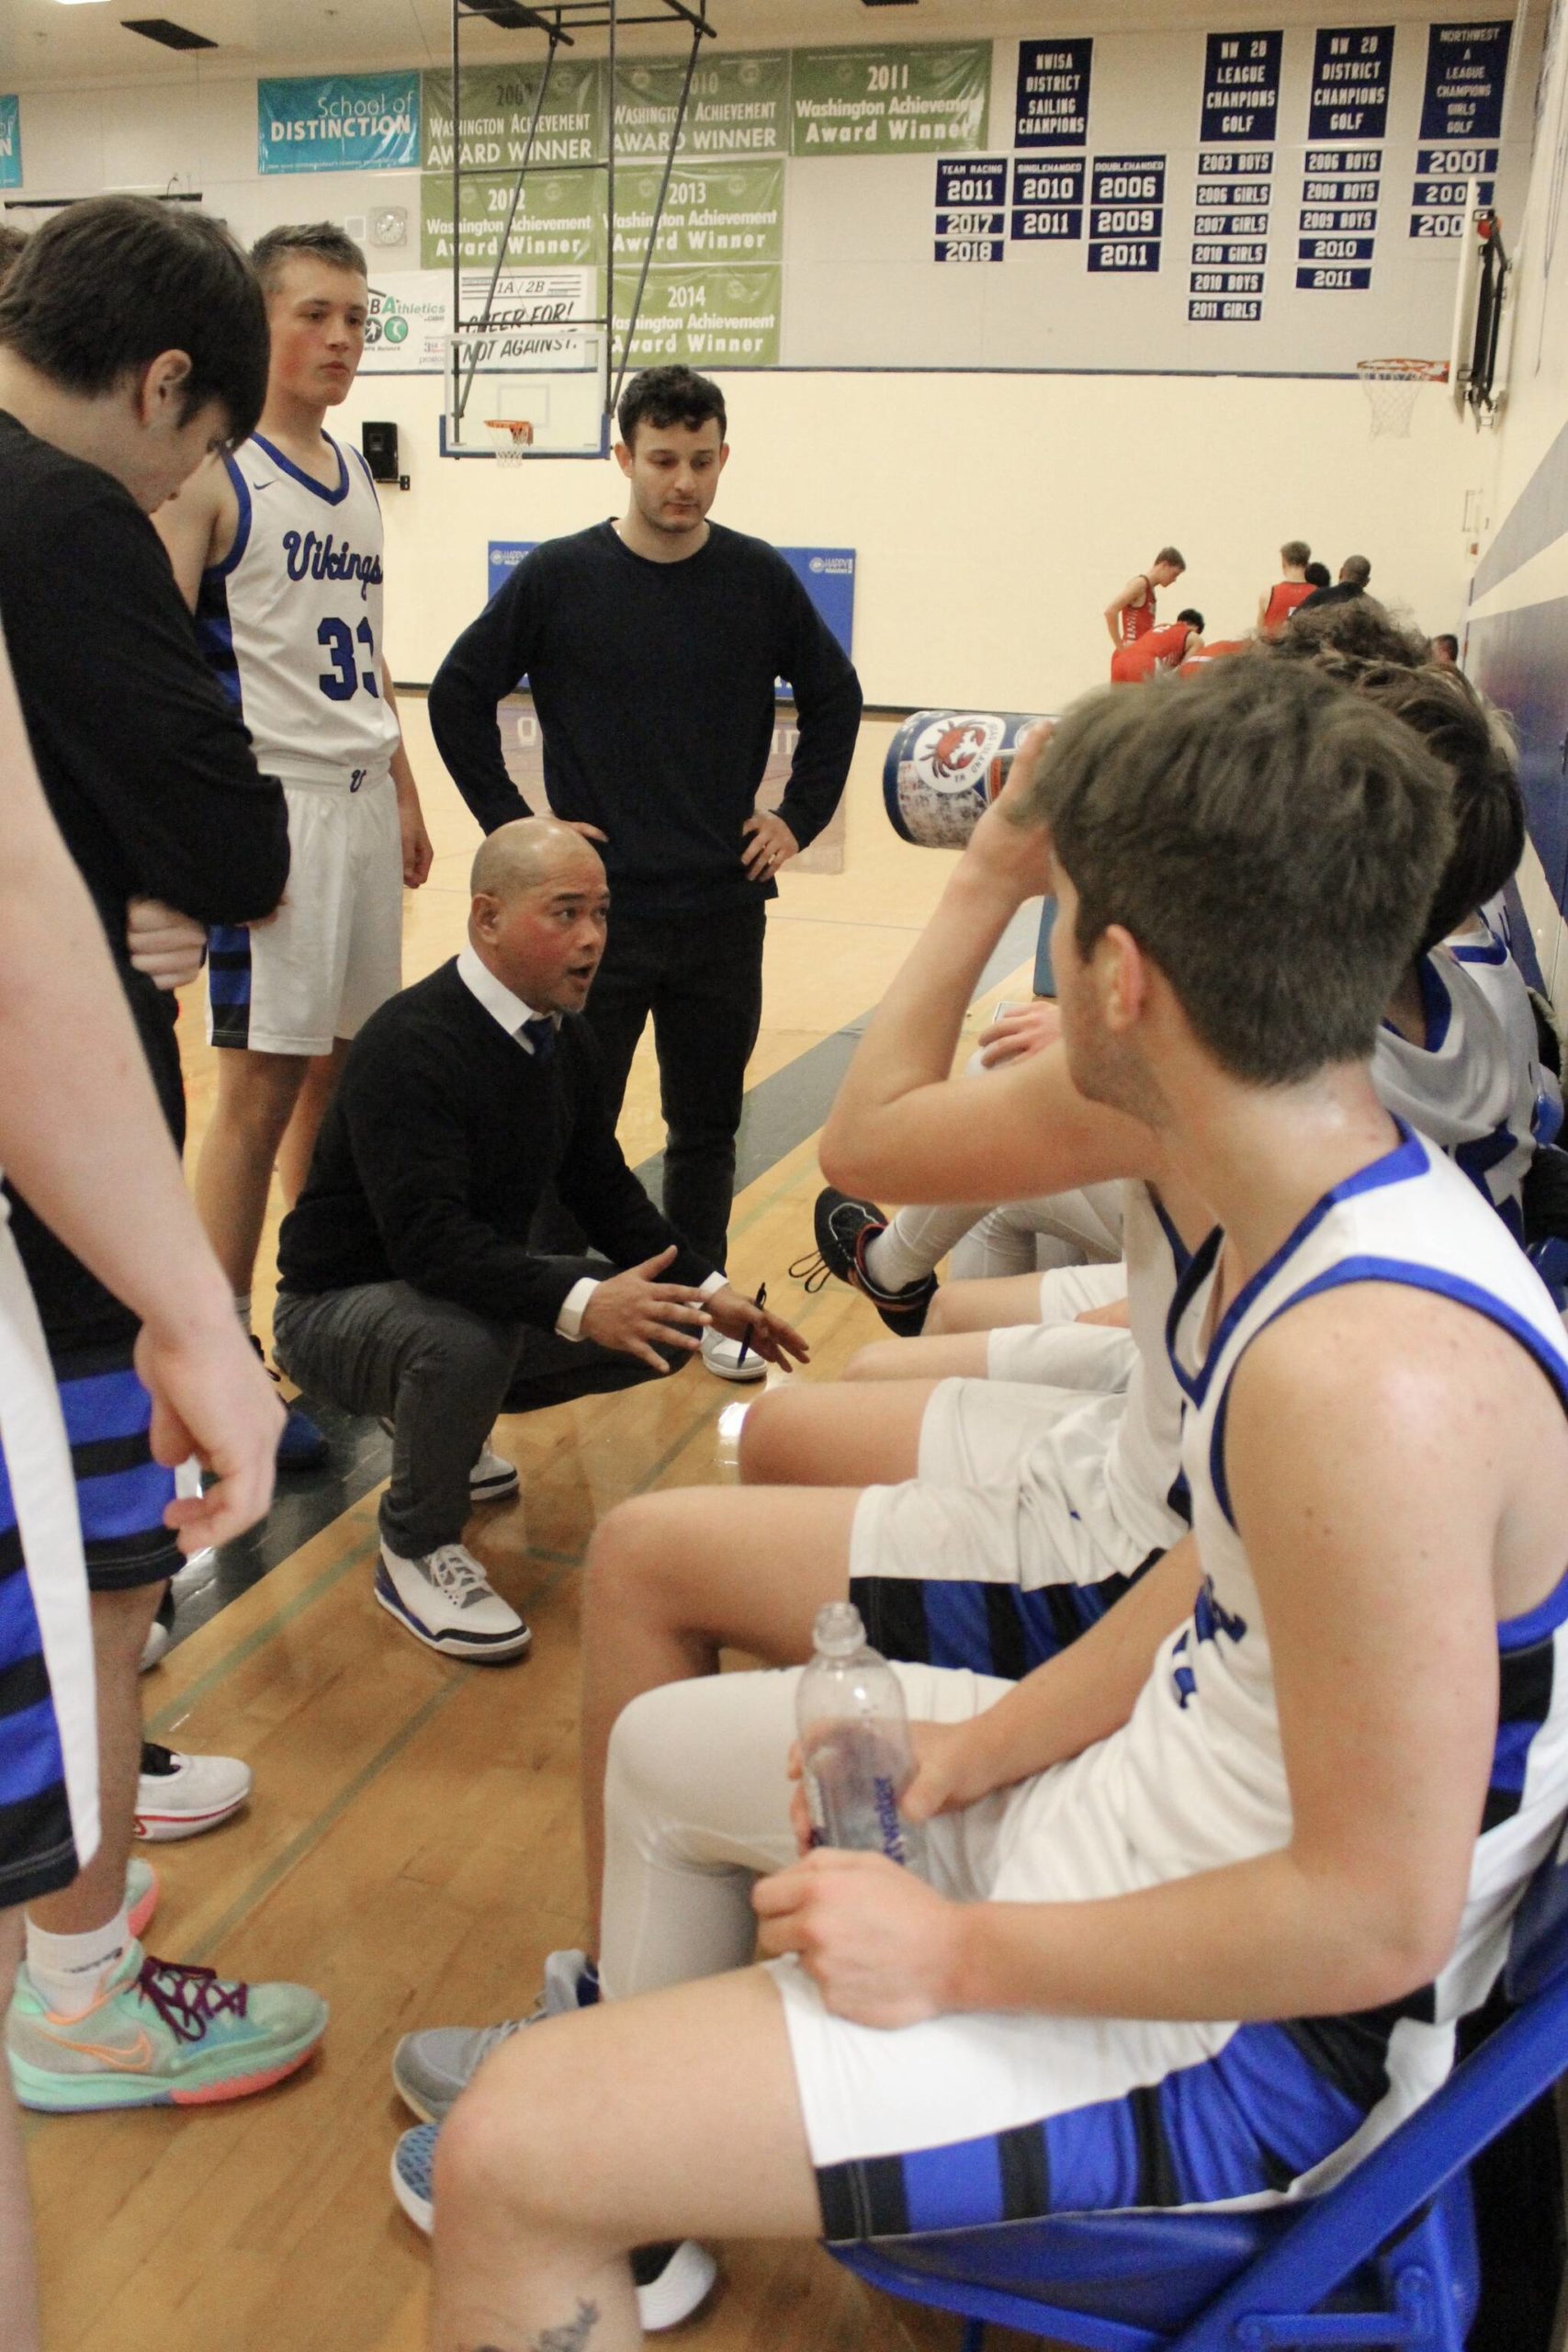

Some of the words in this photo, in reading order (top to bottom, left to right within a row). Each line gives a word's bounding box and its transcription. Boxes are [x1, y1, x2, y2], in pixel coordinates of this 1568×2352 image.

[1036, 53, 1073, 70] NWISA
[867, 64, 908, 91] 2011
[1217, 65, 1266, 84] LEAGUE
[1322, 62, 1381, 81] DISTRICT
[1446, 66, 1485, 80] LEAGUE
[681, 72, 718, 96] 010
[1026, 74, 1081, 92] DISTRICT
[318, 93, 386, 119] School
[392, 90, 414, 114] of
[1206, 90, 1275, 108] CHAMPIONS
[1314, 86, 1385, 107] CHAMPIONS
[694, 101, 776, 121] ACHIEVEMENT
[796, 98, 885, 120] Washington
[1028, 98, 1076, 115] SAILING
[271, 114, 412, 141] DISTINCTION
[806, 119, 877, 142] Award
[888, 118, 971, 141] Winner
[1018, 117, 1085, 134] CHAMPIONS
[1222, 115, 1255, 133] GOLF
[1330, 112, 1364, 130] GOLF
[613, 131, 686, 152] AWARD
[694, 127, 776, 150] WINNER
[427, 142, 501, 164] AWARD
[508, 139, 592, 162] WINNER
[942, 165, 965, 175] TEAM
[970, 164, 1002, 175] RACING
[1017, 163, 1082, 174] SINGLEHANDED
[1095, 161, 1164, 172] DOUBLEHANDED
[1237, 153, 1269, 171] BOYS
[1345, 153, 1377, 170] BOYS
[1429, 151, 1486, 173] 2001
[669, 182, 706, 205] 2013
[947, 179, 993, 200] 2011
[1022, 177, 1074, 199] 2010
[1100, 176, 1156, 198] 2006
[1233, 187, 1268, 203] GIRLS
[1343, 183, 1375, 199] BOYS
[1426, 186, 1481, 203] 200
[688, 209, 778, 227] Achievement
[947, 214, 993, 234] 2017
[1023, 212, 1068, 234] 2011
[1098, 210, 1155, 232] 2009
[1231, 216, 1267, 233] GIRLS
[1339, 211, 1372, 229] BOYS
[507, 235, 581, 254] Winner
[689, 231, 765, 249] Winner
[1314, 241, 1357, 257] 2010
[945, 242, 992, 261] 2018
[1100, 244, 1146, 266] 2011
[1195, 246, 1223, 263] 2010
[1228, 245, 1263, 262] GIRLS
[1194, 275, 1223, 291] 2010
[1228, 274, 1258, 290] BOYS
[1314, 270, 1352, 287] 2011
[668, 286, 705, 308] 2014
[1192, 302, 1217, 319] 2011
[1223, 302, 1258, 319] GIRLS
[687, 312, 775, 329] Achievement
[463, 341, 498, 363] NOT
[612, 334, 676, 353] Award
[687, 334, 763, 353] Winner
[283, 530, 383, 601] Vikings
